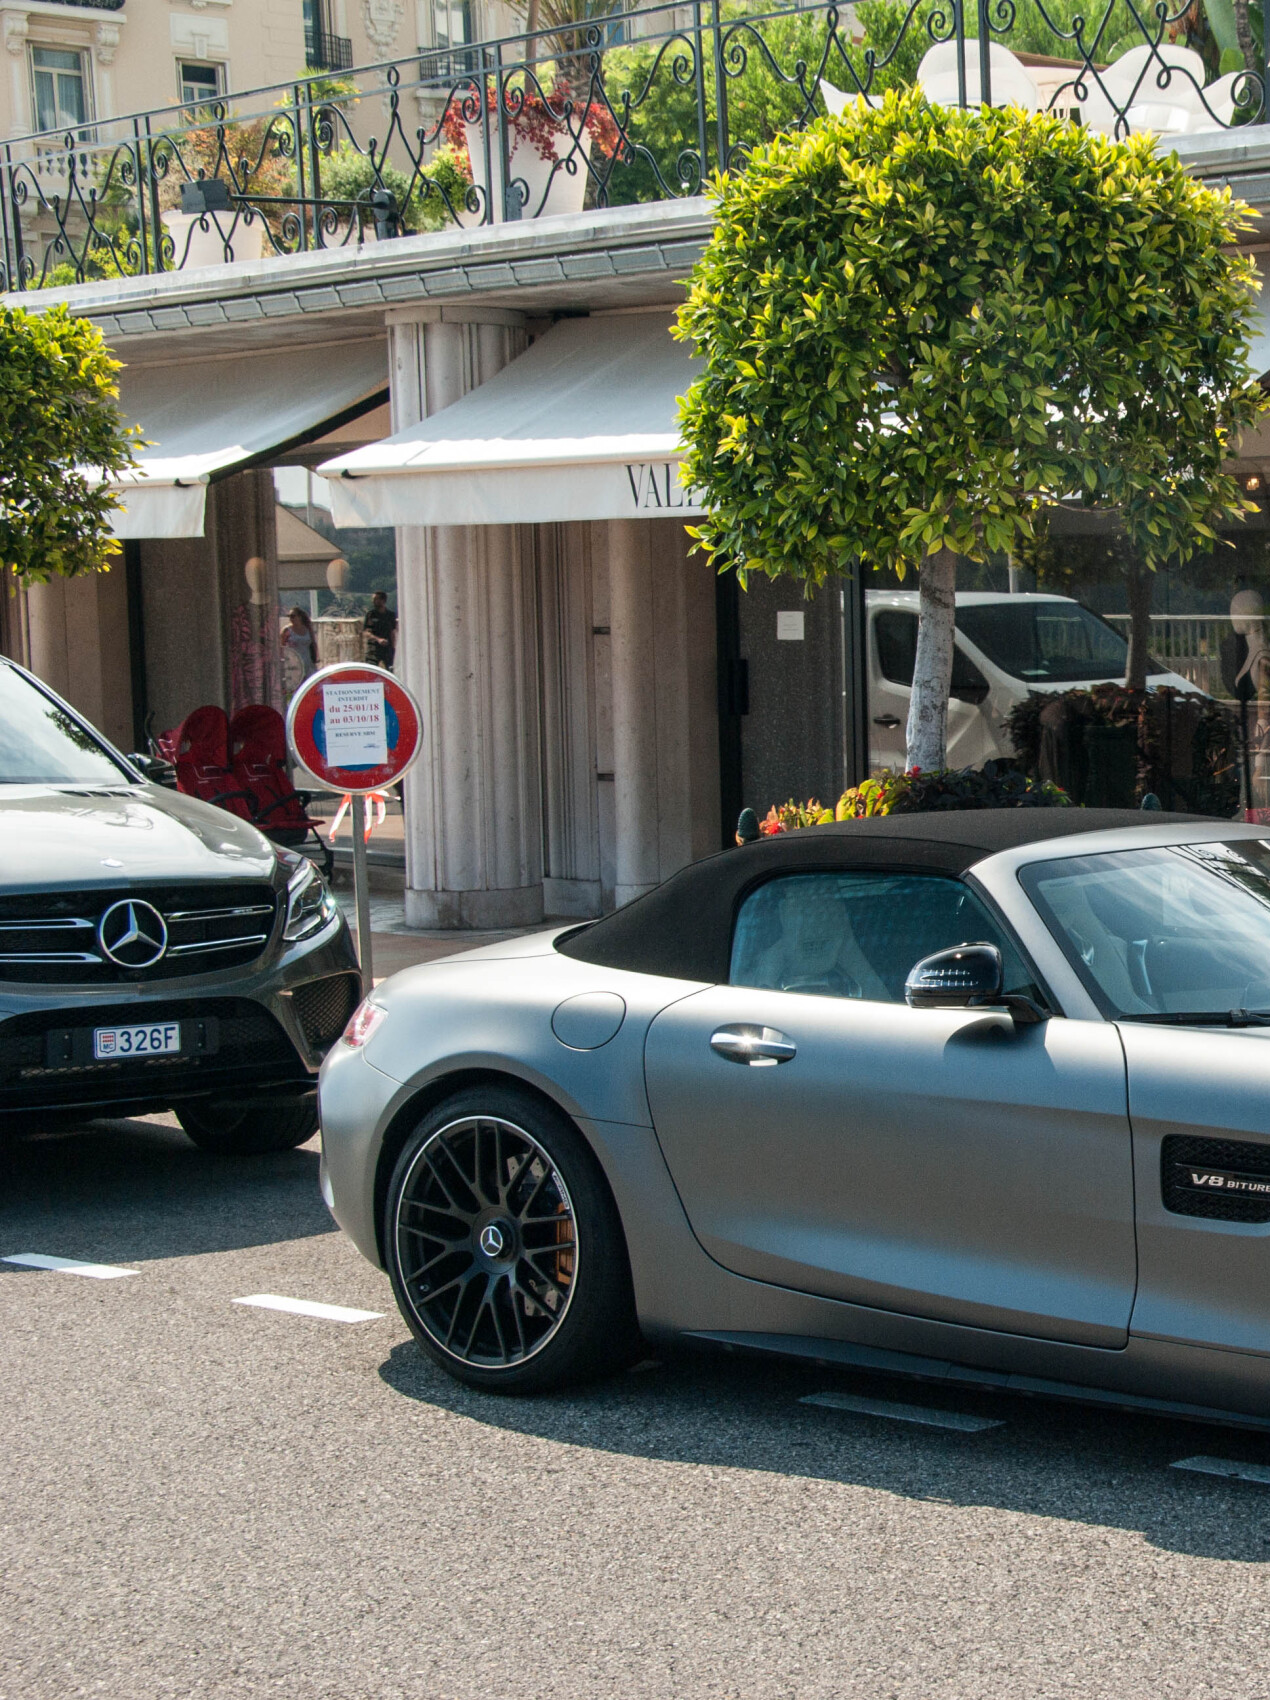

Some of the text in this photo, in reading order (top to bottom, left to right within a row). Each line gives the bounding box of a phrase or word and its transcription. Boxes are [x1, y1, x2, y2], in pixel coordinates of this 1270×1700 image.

[325, 688, 380, 696] STATIONNEMENT
[329, 703, 380, 713] du 25/01/18
[342, 714, 380, 723] 03/10/18
[120, 1026, 176, 1053] 326F
[1191, 1173, 1225, 1187] V8
